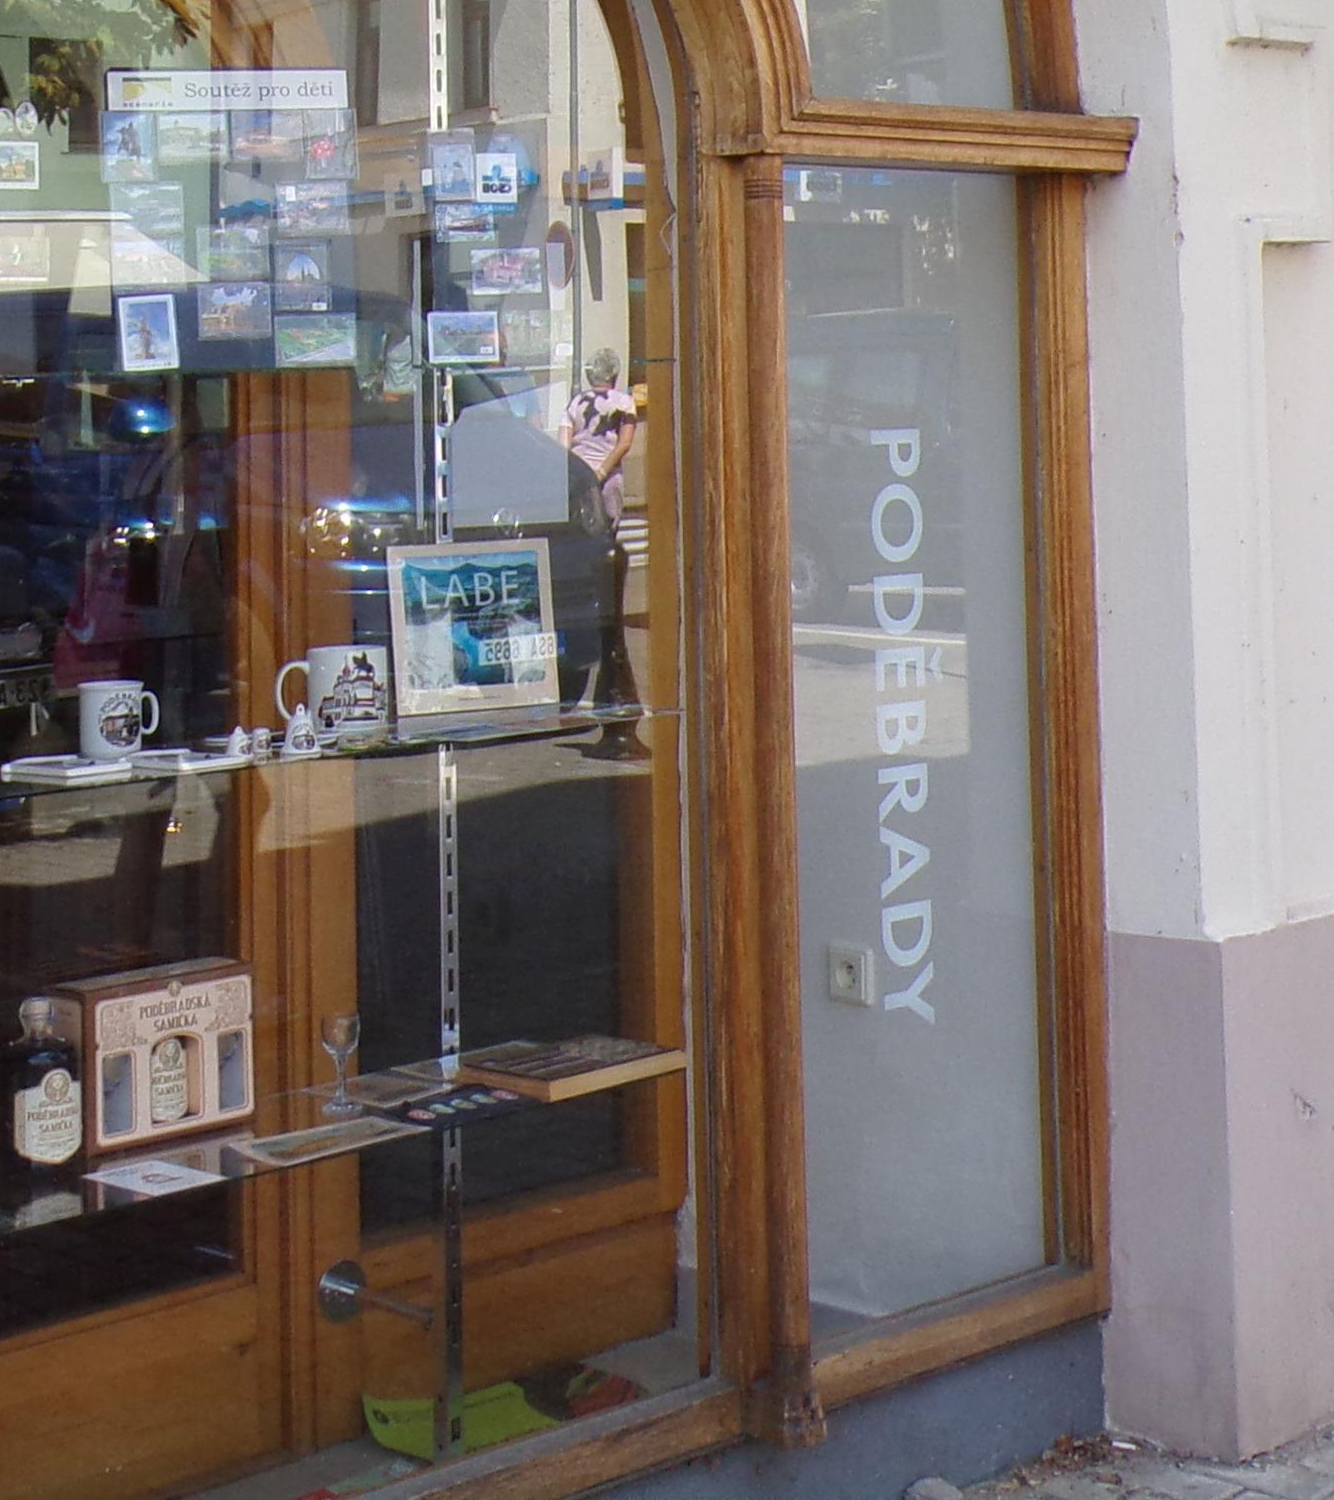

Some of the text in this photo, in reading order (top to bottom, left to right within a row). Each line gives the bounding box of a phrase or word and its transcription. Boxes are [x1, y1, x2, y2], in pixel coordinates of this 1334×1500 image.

[184, 80, 334, 101] Soutěž pro děti
[421, 570, 521, 610] LABE
[870, 428, 943, 1025] PODĚBRADY
